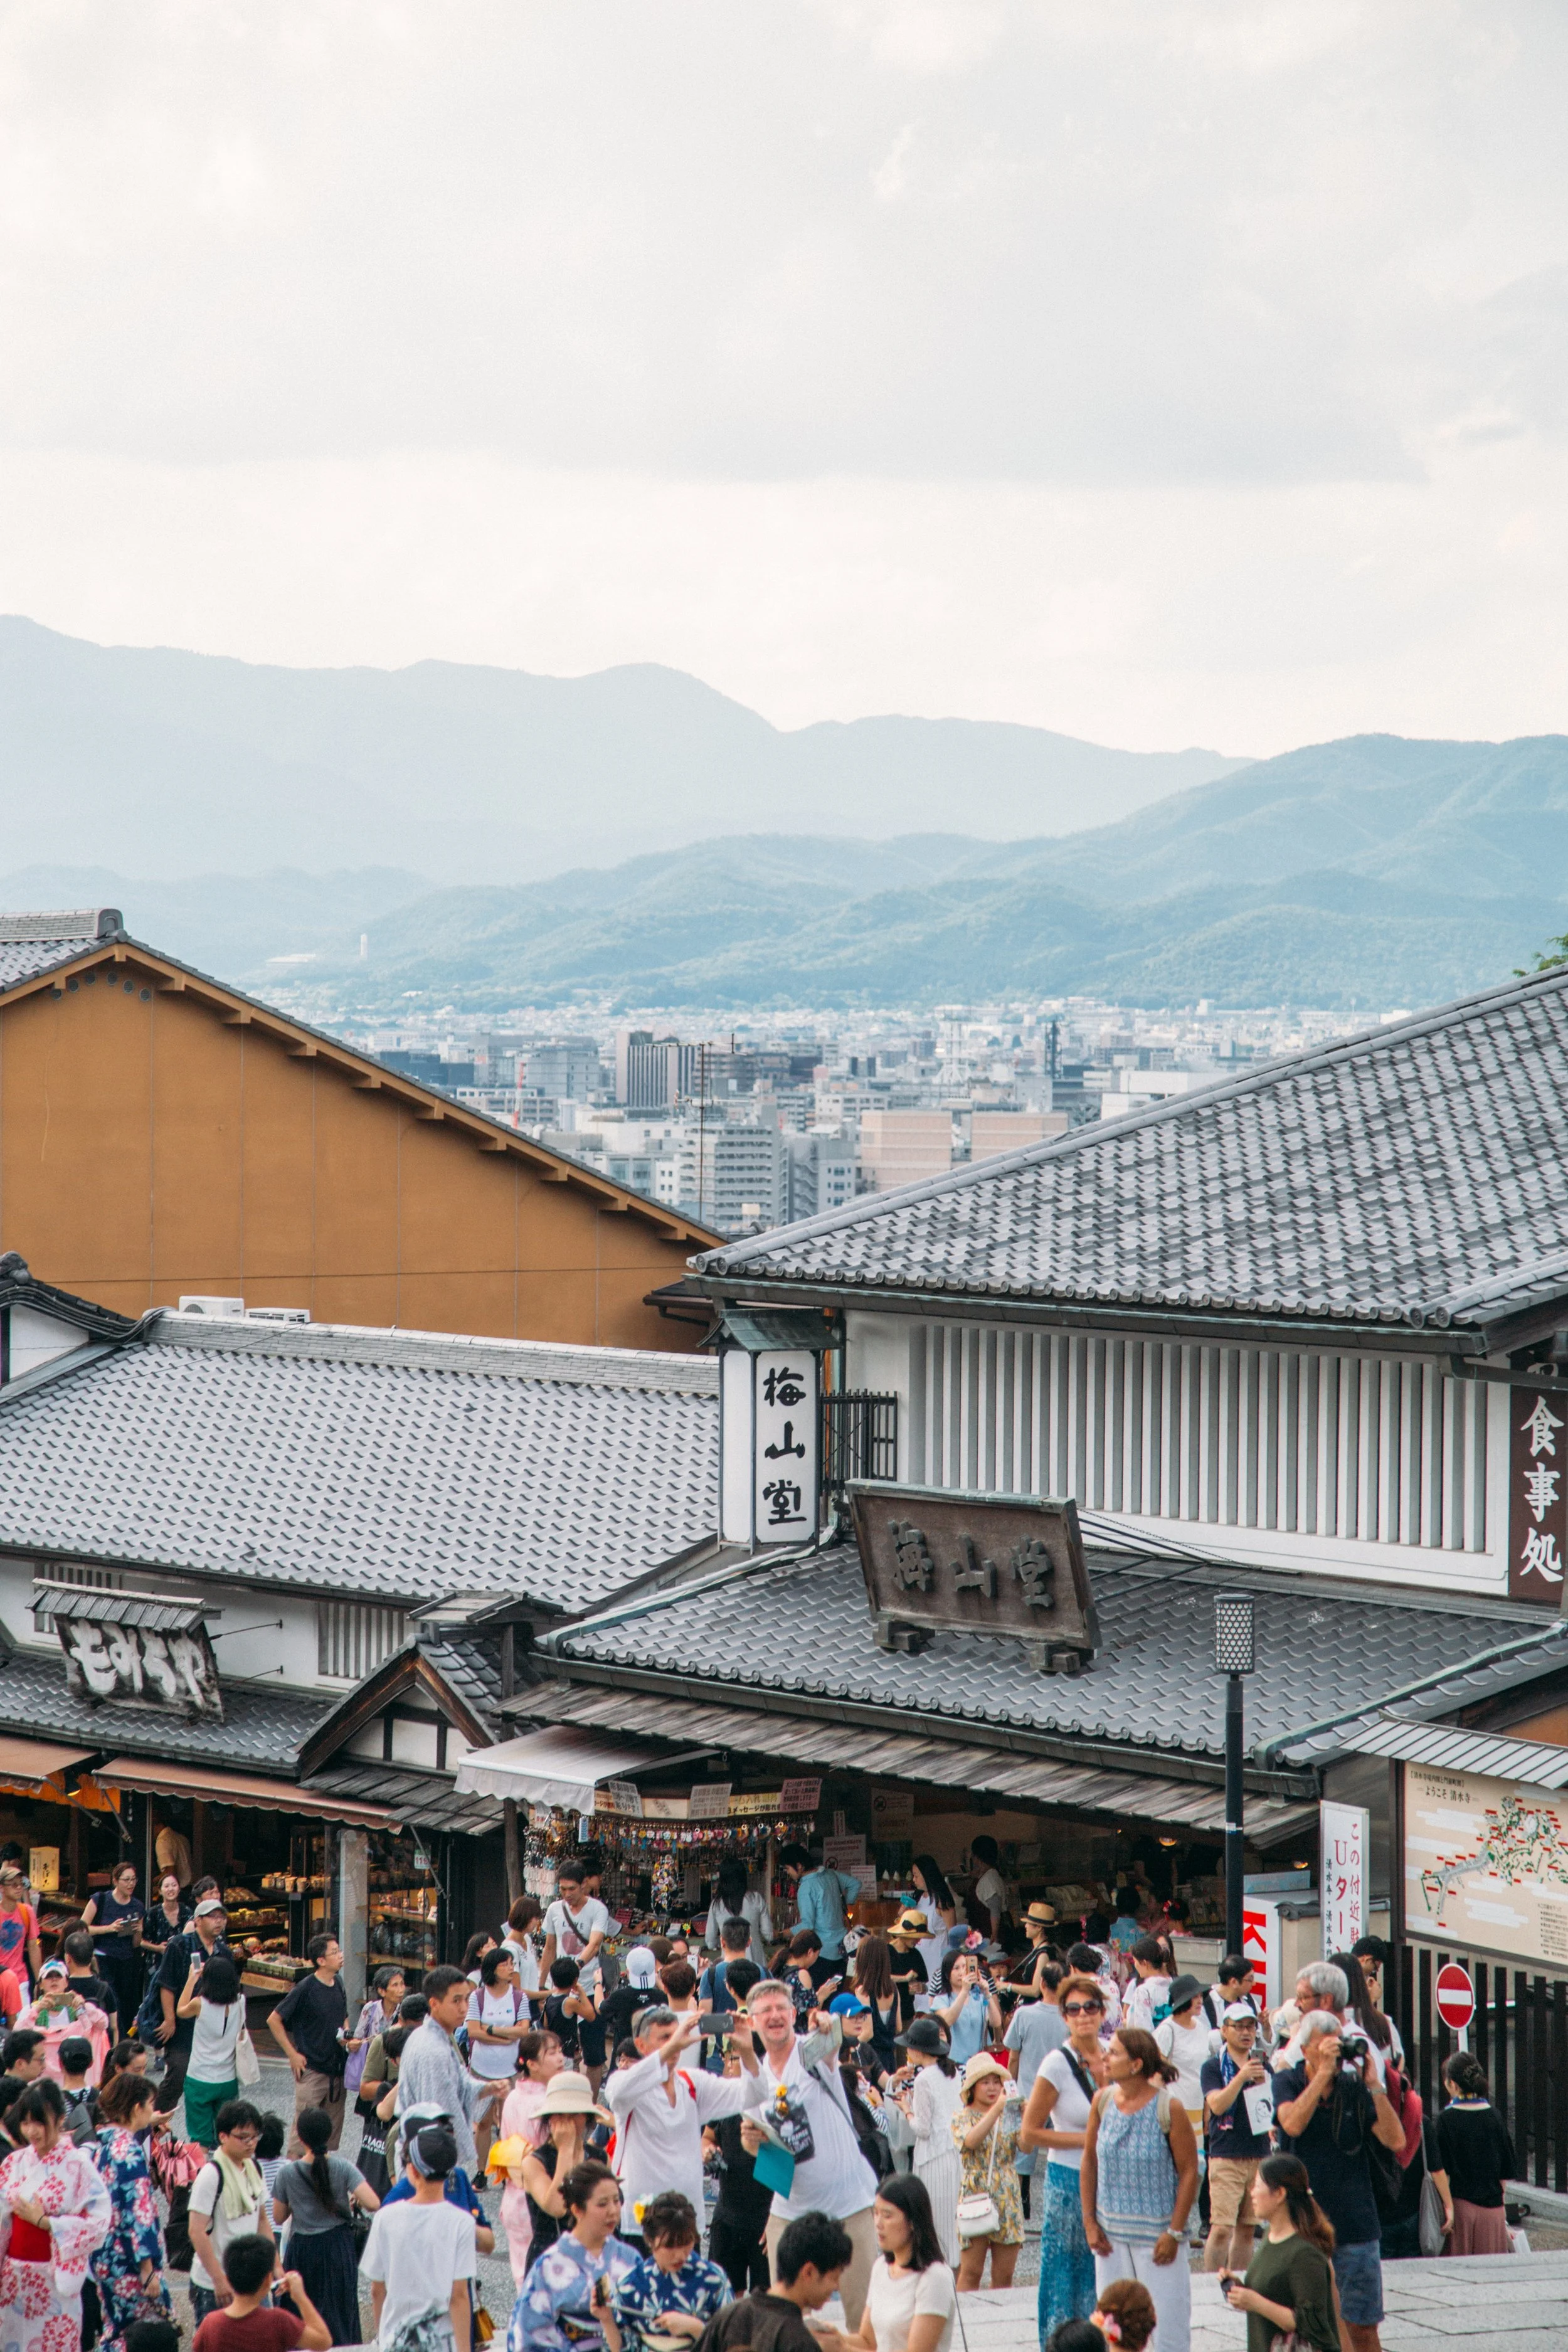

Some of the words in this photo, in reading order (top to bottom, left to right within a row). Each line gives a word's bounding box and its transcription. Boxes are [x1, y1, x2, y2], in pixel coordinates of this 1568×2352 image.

[763, 1367, 807, 1525] 梅山堂
[1426, 1786, 1447, 1799] ようこそ
[1450, 1789, 1471, 1804] 清水寺
[562, 1921, 584, 1930] LVE
[1335, 1840, 1348, 1953] Uター
